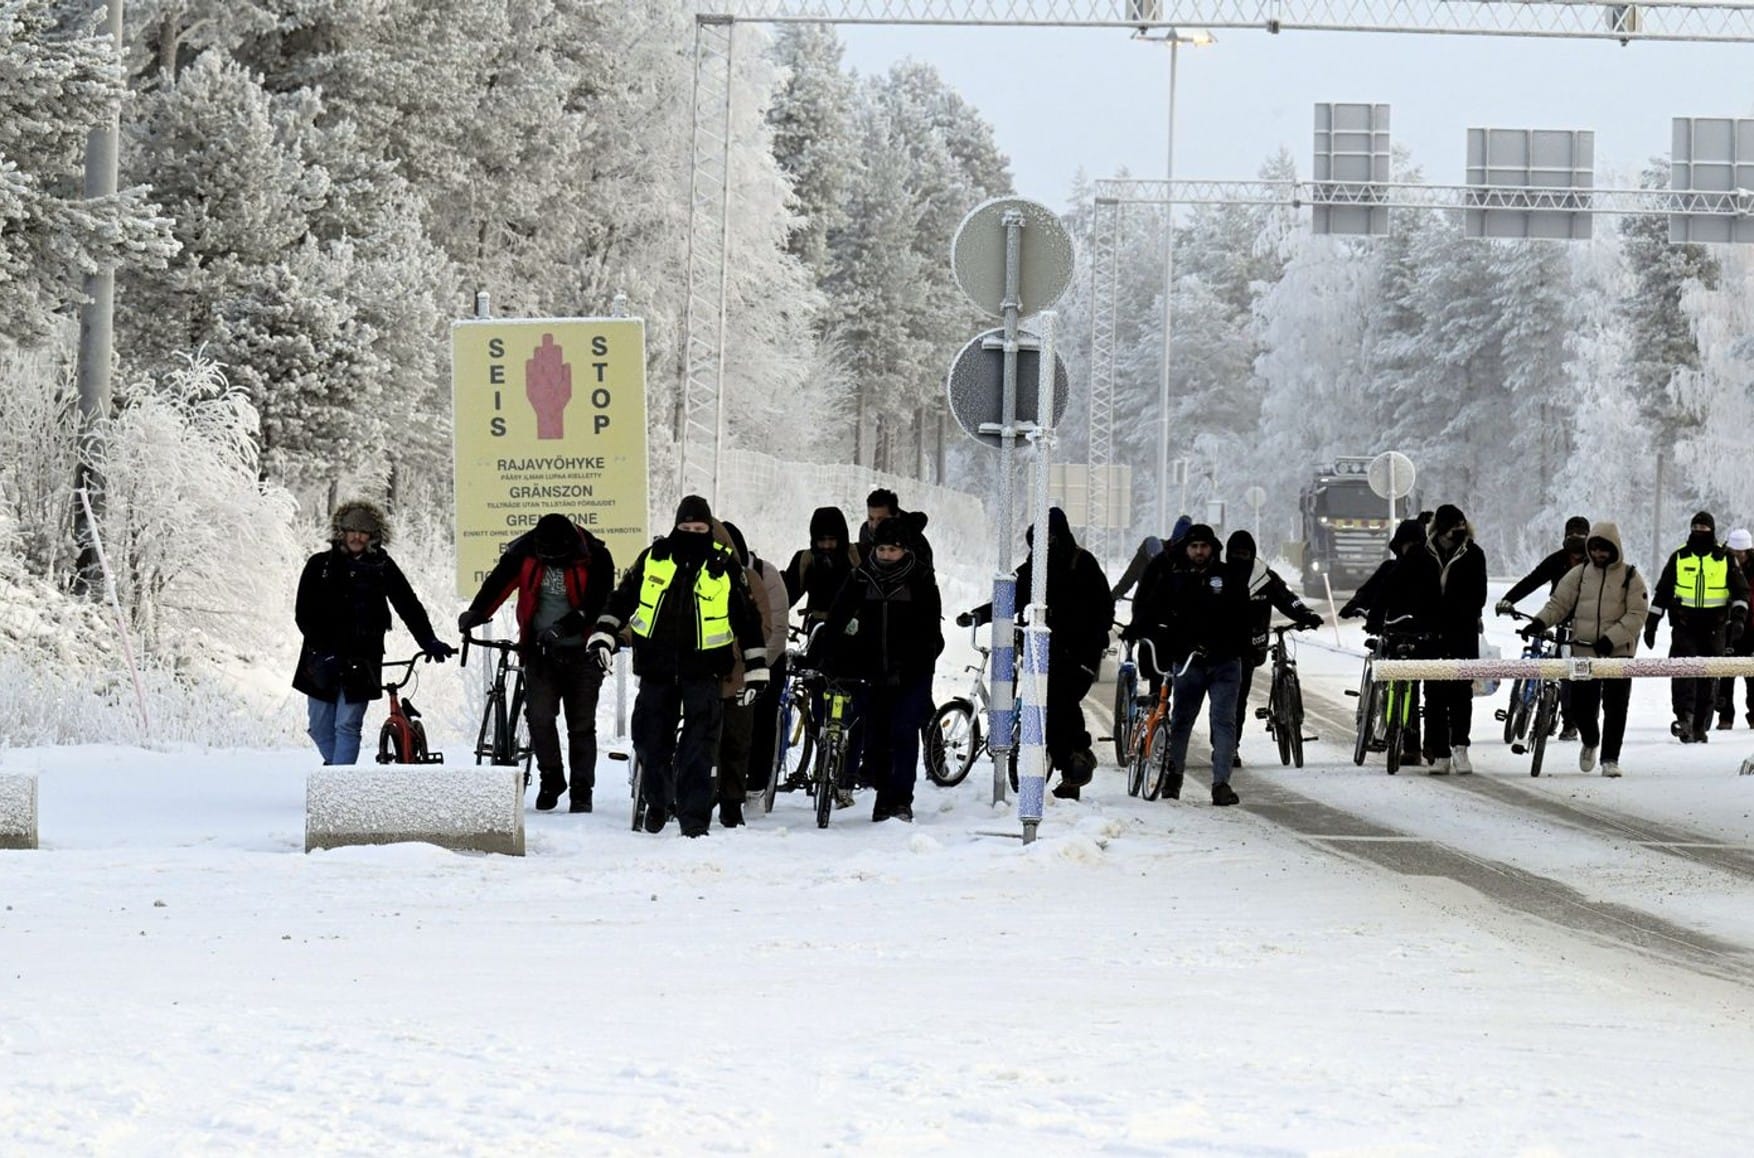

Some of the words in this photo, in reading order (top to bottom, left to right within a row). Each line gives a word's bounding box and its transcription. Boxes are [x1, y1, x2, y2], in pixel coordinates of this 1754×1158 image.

[488, 338, 507, 437] SEIS
[591, 336, 611, 435] STOP
[497, 455, 605, 471] RAJAVYÖHYKE
[509, 483, 593, 499] GRÄNSZON
